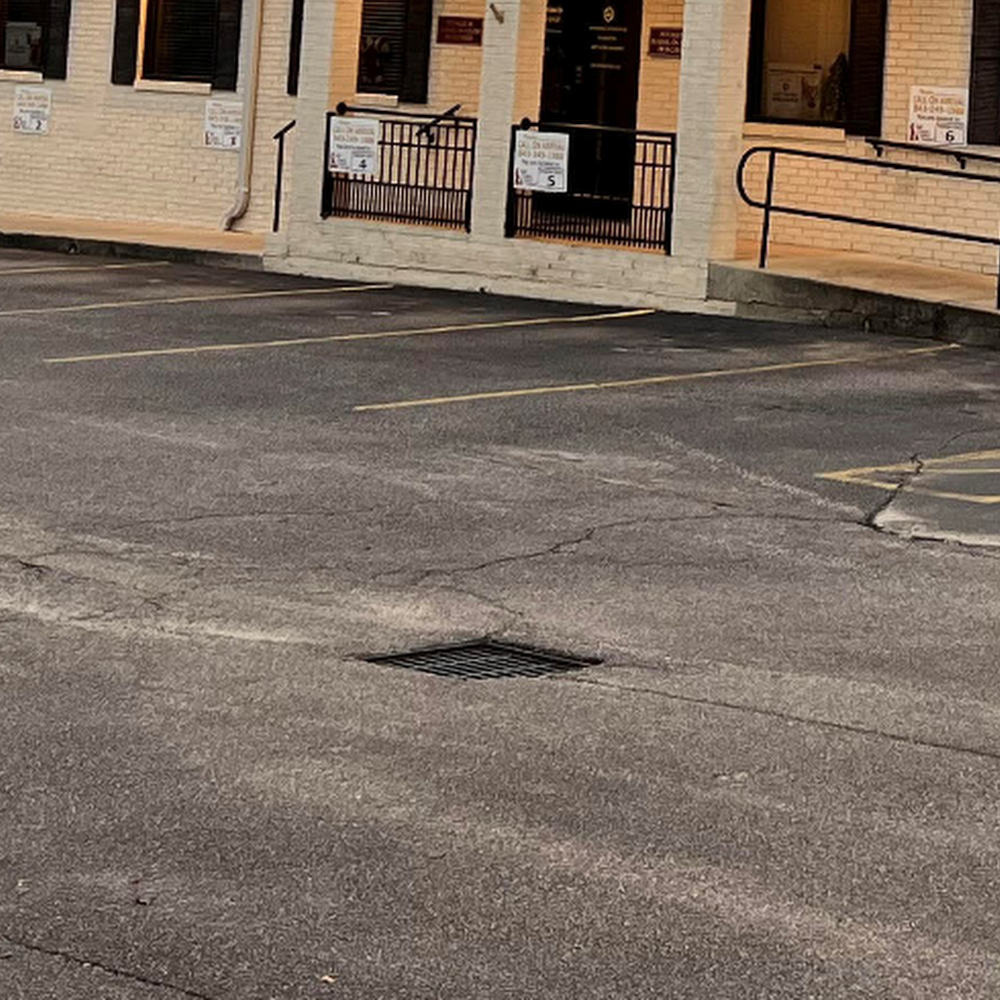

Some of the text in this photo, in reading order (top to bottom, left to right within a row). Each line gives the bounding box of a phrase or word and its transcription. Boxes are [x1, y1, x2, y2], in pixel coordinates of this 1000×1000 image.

[945, 130, 955, 141] 6
[358, 159, 367, 168] 4
[547, 175, 556, 187] 5
